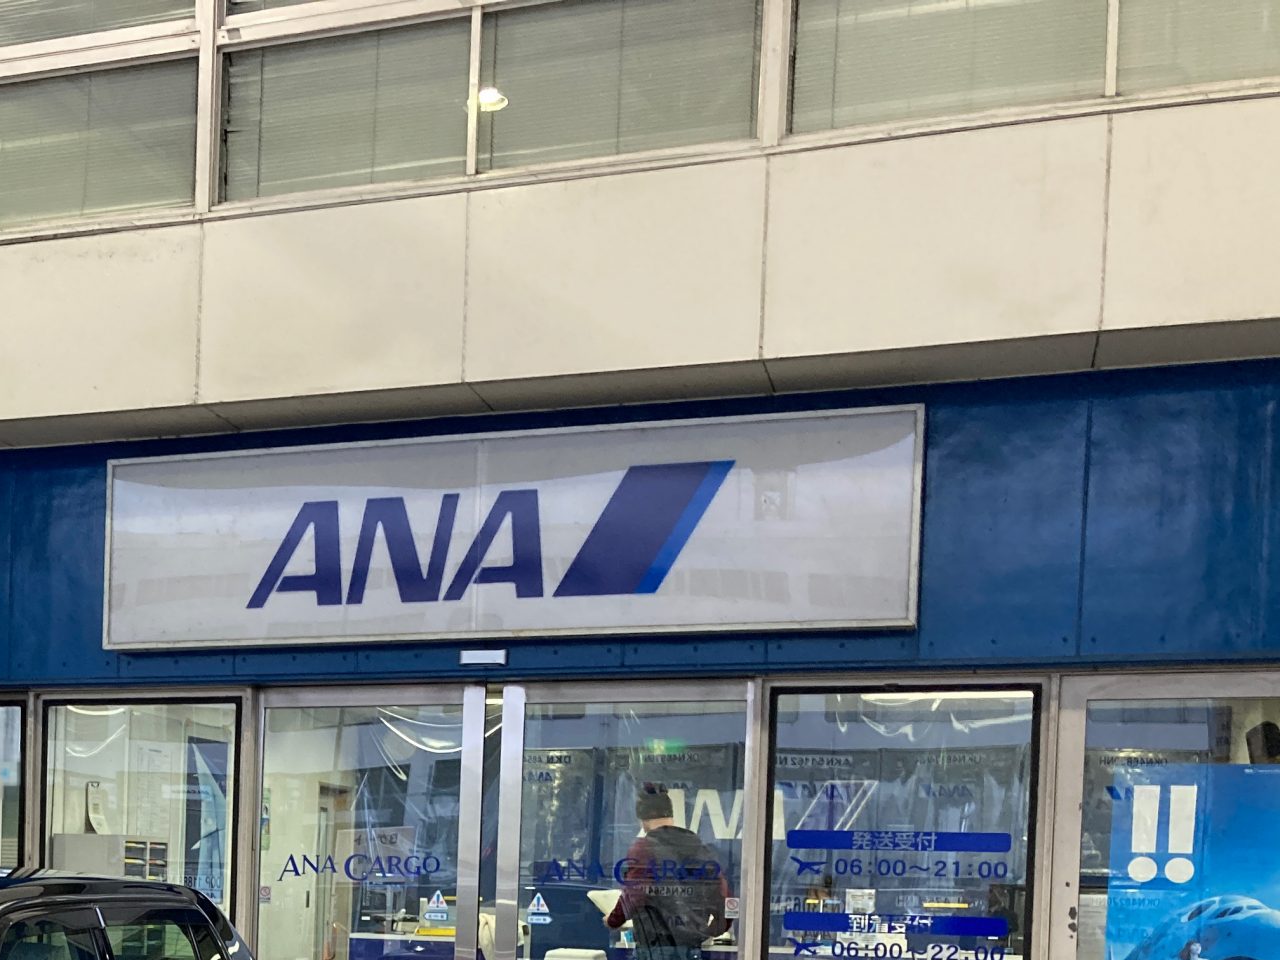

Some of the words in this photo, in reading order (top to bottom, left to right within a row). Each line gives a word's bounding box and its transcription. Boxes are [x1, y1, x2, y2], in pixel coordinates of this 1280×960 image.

[246, 488, 544, 609] ANA
[852, 832, 937, 851] 発送受付
[277, 853, 338, 882] ANA
[344, 853, 441, 882] CARGO
[541, 858, 606, 886] ANA
[614, 857, 721, 886] CARGO
